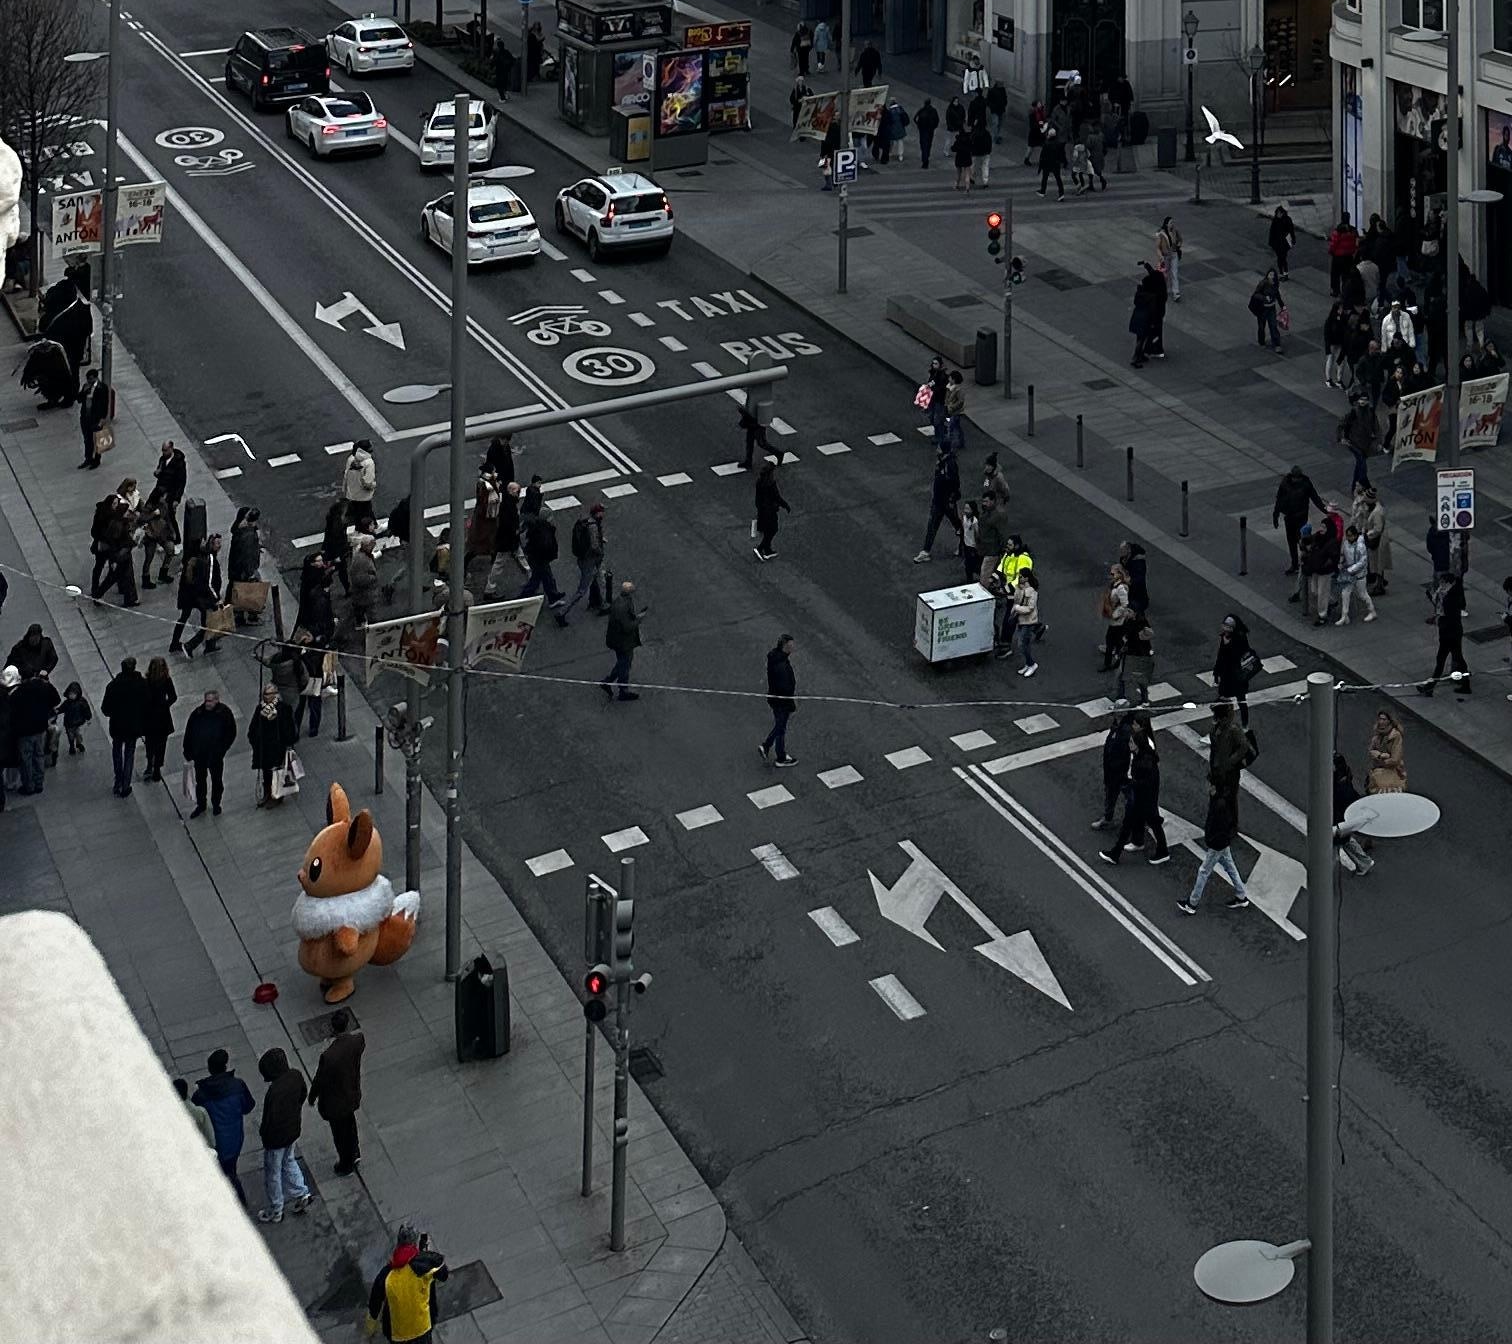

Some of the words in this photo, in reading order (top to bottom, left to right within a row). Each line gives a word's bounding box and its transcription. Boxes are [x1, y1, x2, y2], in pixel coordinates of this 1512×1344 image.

[837, 151, 854, 173] P
[58, 196, 84, 210] SAN
[656, 289, 769, 321] TAXI
[720, 331, 824, 366] BUS
[582, 354, 636, 378] 30
[1469, 394, 1493, 405] 16-18
[1401, 431, 1435, 447] NTÓN
[938, 619, 966, 631] GREEN
[938, 632, 968, 644] FRIEND
